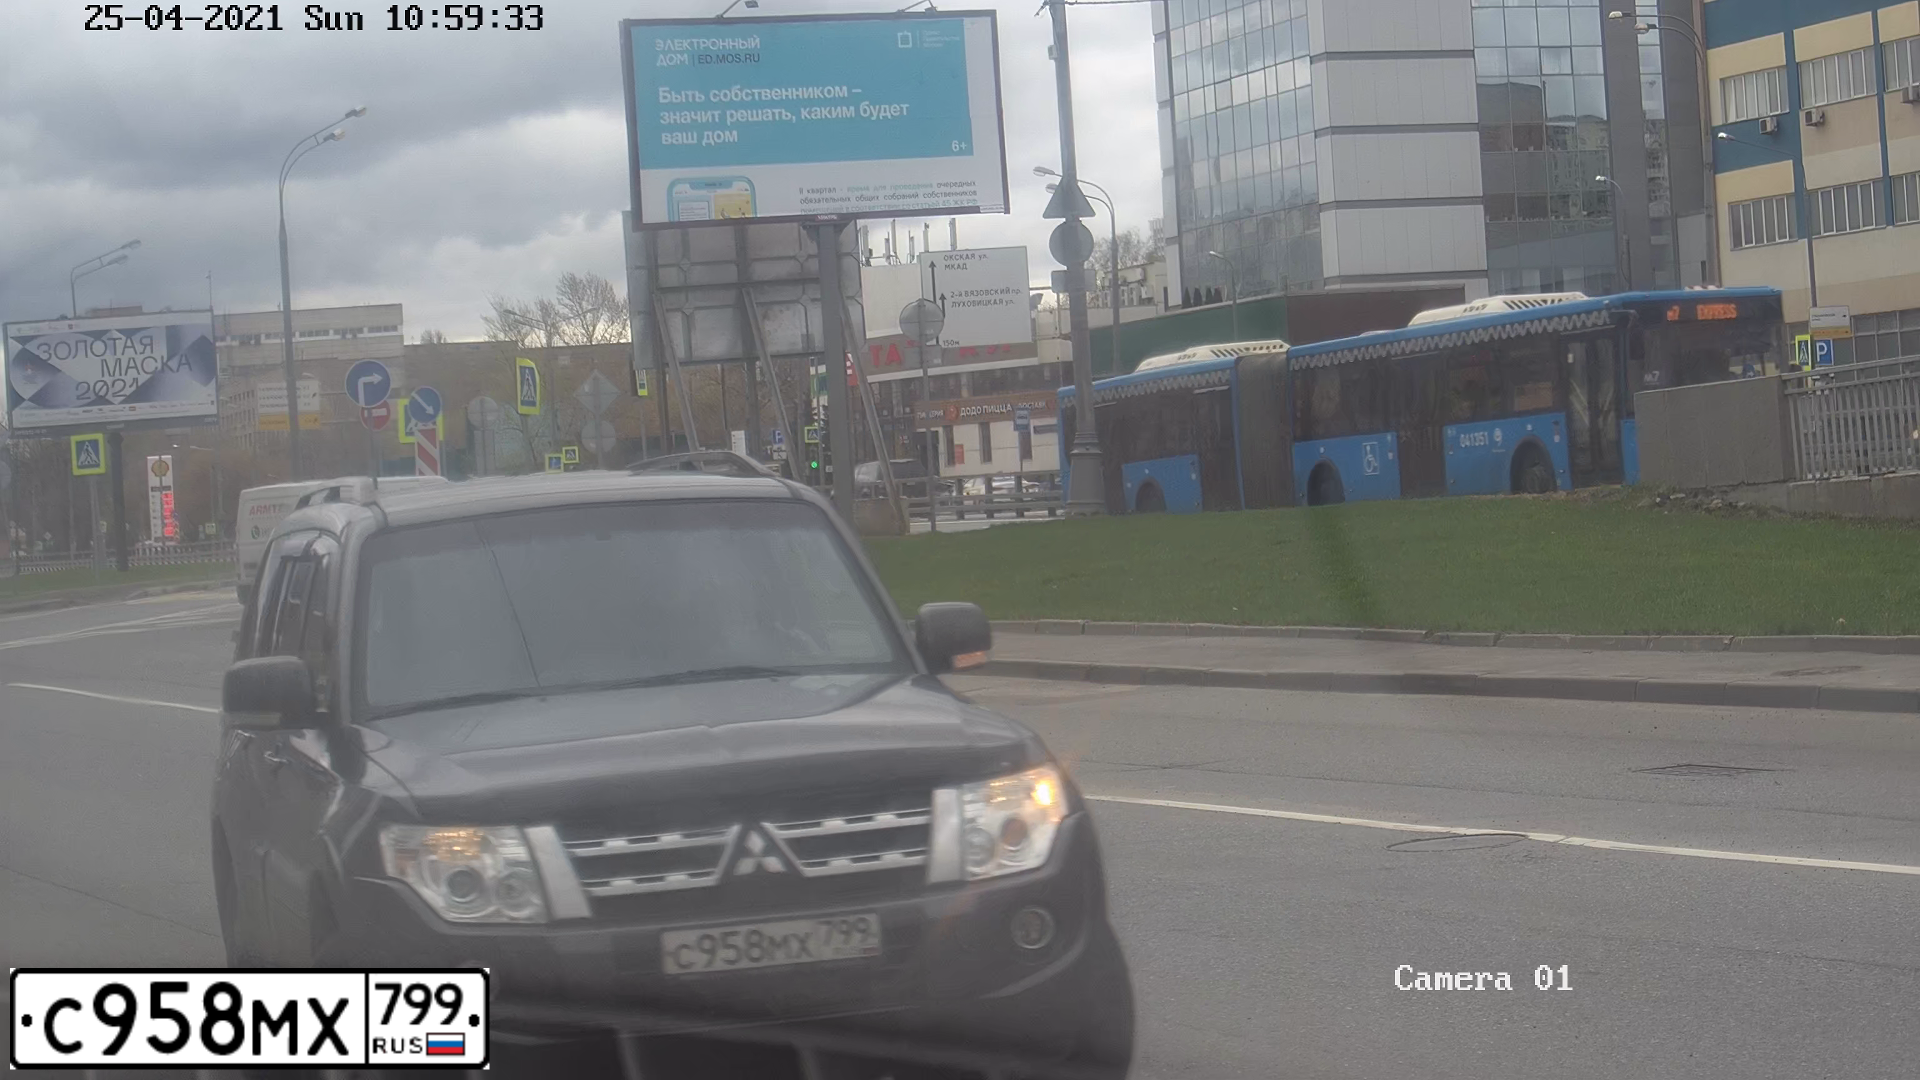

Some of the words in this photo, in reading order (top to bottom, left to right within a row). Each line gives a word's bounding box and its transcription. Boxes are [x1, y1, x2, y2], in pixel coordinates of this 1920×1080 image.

[654, 35, 760, 51] ЭЛЕКТРОННЫЙ
[656, 53, 688, 67] ДОМ
[698, 53, 760, 65] ED.MOS.RU
[658, 86, 705, 104] Быть
[709, 84, 848, 103] собственником
[660, 109, 720, 125] значит
[726, 107, 796, 126] решать,
[801, 103, 855, 120] каким
[859, 101, 909, 120] будет
[661, 130, 697, 145] ваш
[702, 130, 738, 146] дом
[952, 140, 967, 151] 6+
[807, 187, 837, 195] квартал
[936, 180, 976, 190] очередных
[800, 196, 851, 205] обязательных
[855, 194, 880, 203] общих
[883, 192, 919, 201] собраний
[922, 190, 977, 199] собственников
[943, 253, 975, 261] ОКСКАЯ
[944, 263, 968, 271] МКАД
[964, 287, 1010, 297] ВЯЗОВСКИЙ
[951, 299, 1003, 308] ЛУХОВИЦКАЯ
[37, 335, 154, 363] ЗОЛОТАЯ
[101, 354, 192, 378] МАСКА
[76, 377, 140, 400] 2021
[960, 407, 981, 417] ДОДО
[983, 404, 1012, 414] ПИЦЦА
[815, 917, 872, 949] 799
